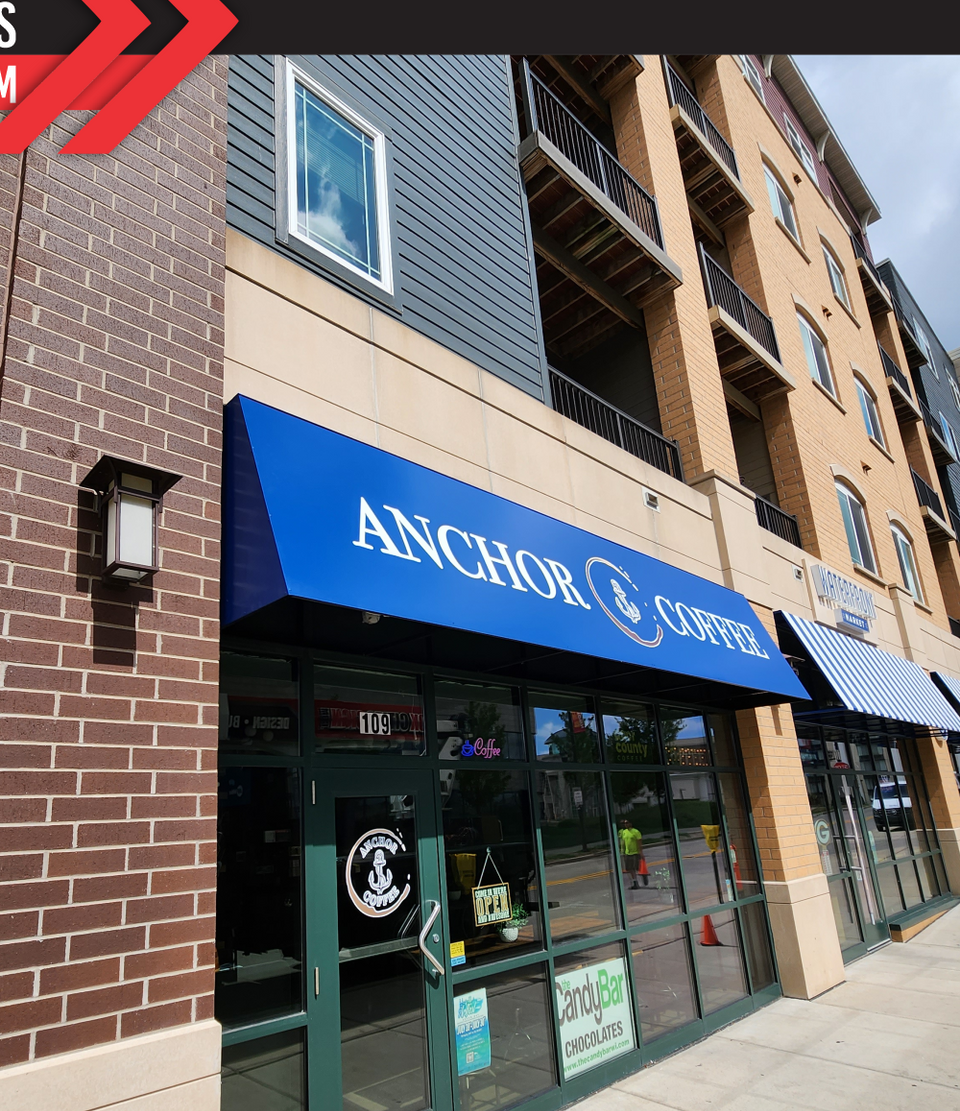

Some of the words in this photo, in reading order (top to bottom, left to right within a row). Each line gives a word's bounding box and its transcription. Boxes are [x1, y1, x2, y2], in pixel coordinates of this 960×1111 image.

[352, 496, 592, 610] ANCHOR
[654, 594, 771, 660] COFFEE
[816, 565, 877, 620] WATERFRONT
[844, 612, 866, 628] MARKET
[362, 713, 390, 734] 109
[474, 737, 501, 759] Coffee
[615, 740, 648, 758] county
[360, 836, 399, 860] ANCHOR
[475, 894, 510, 917] OPEN
[555, 968, 624, 1027] CandyBar
[565, 1020, 624, 1059] CHOCOLATES
